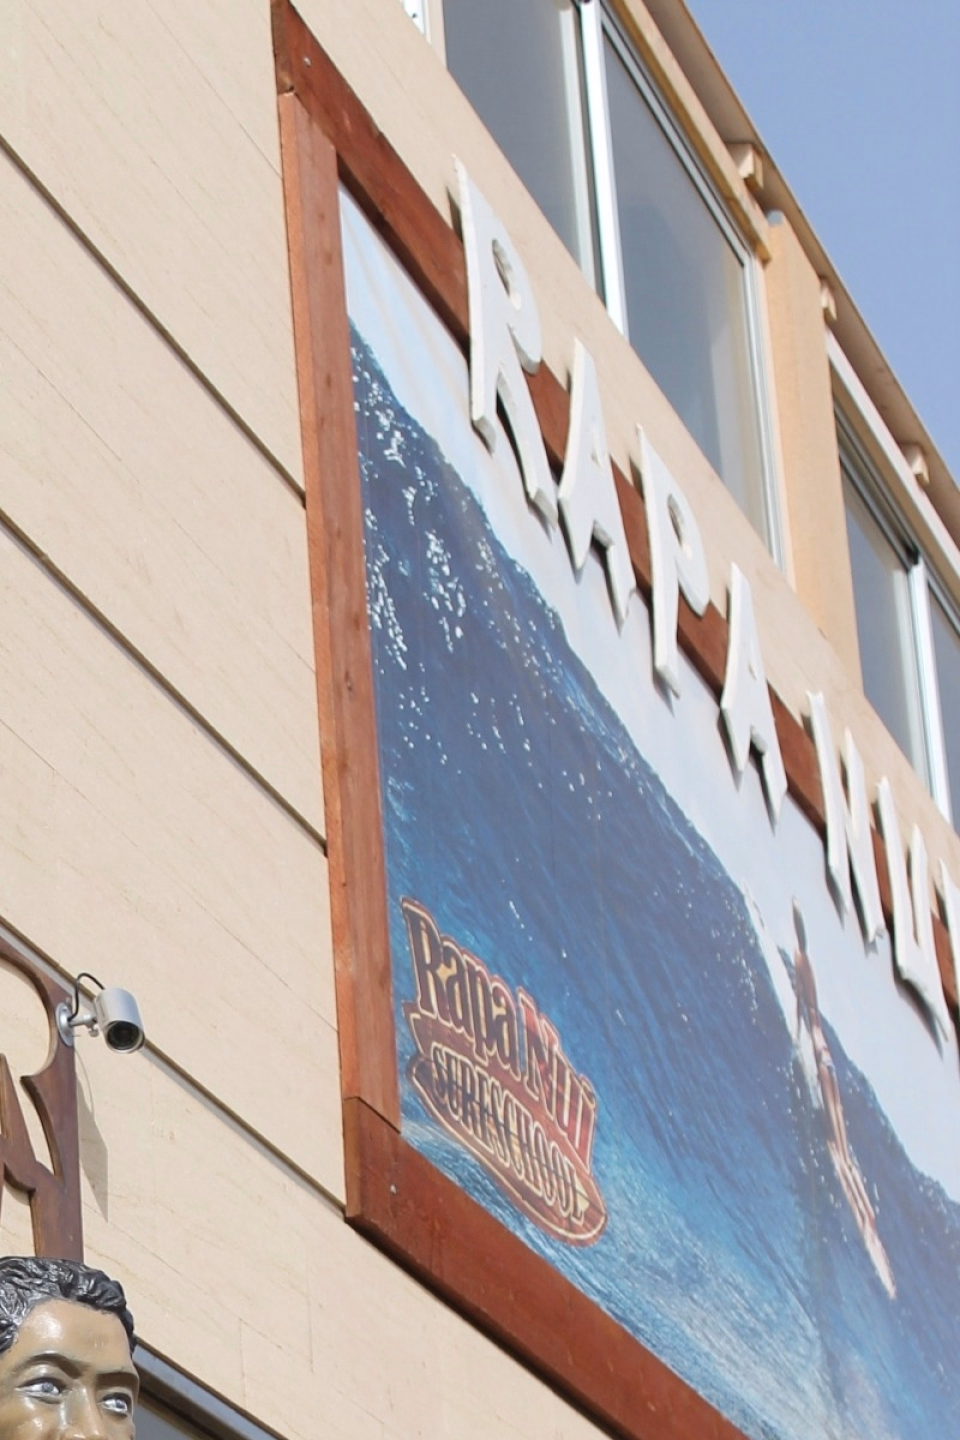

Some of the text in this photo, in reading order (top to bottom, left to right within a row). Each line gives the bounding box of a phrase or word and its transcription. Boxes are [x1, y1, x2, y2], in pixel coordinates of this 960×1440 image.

[401, 898, 597, 1175] Rapa Nui
[430, 1042, 587, 1226] SURFSCHOOL
